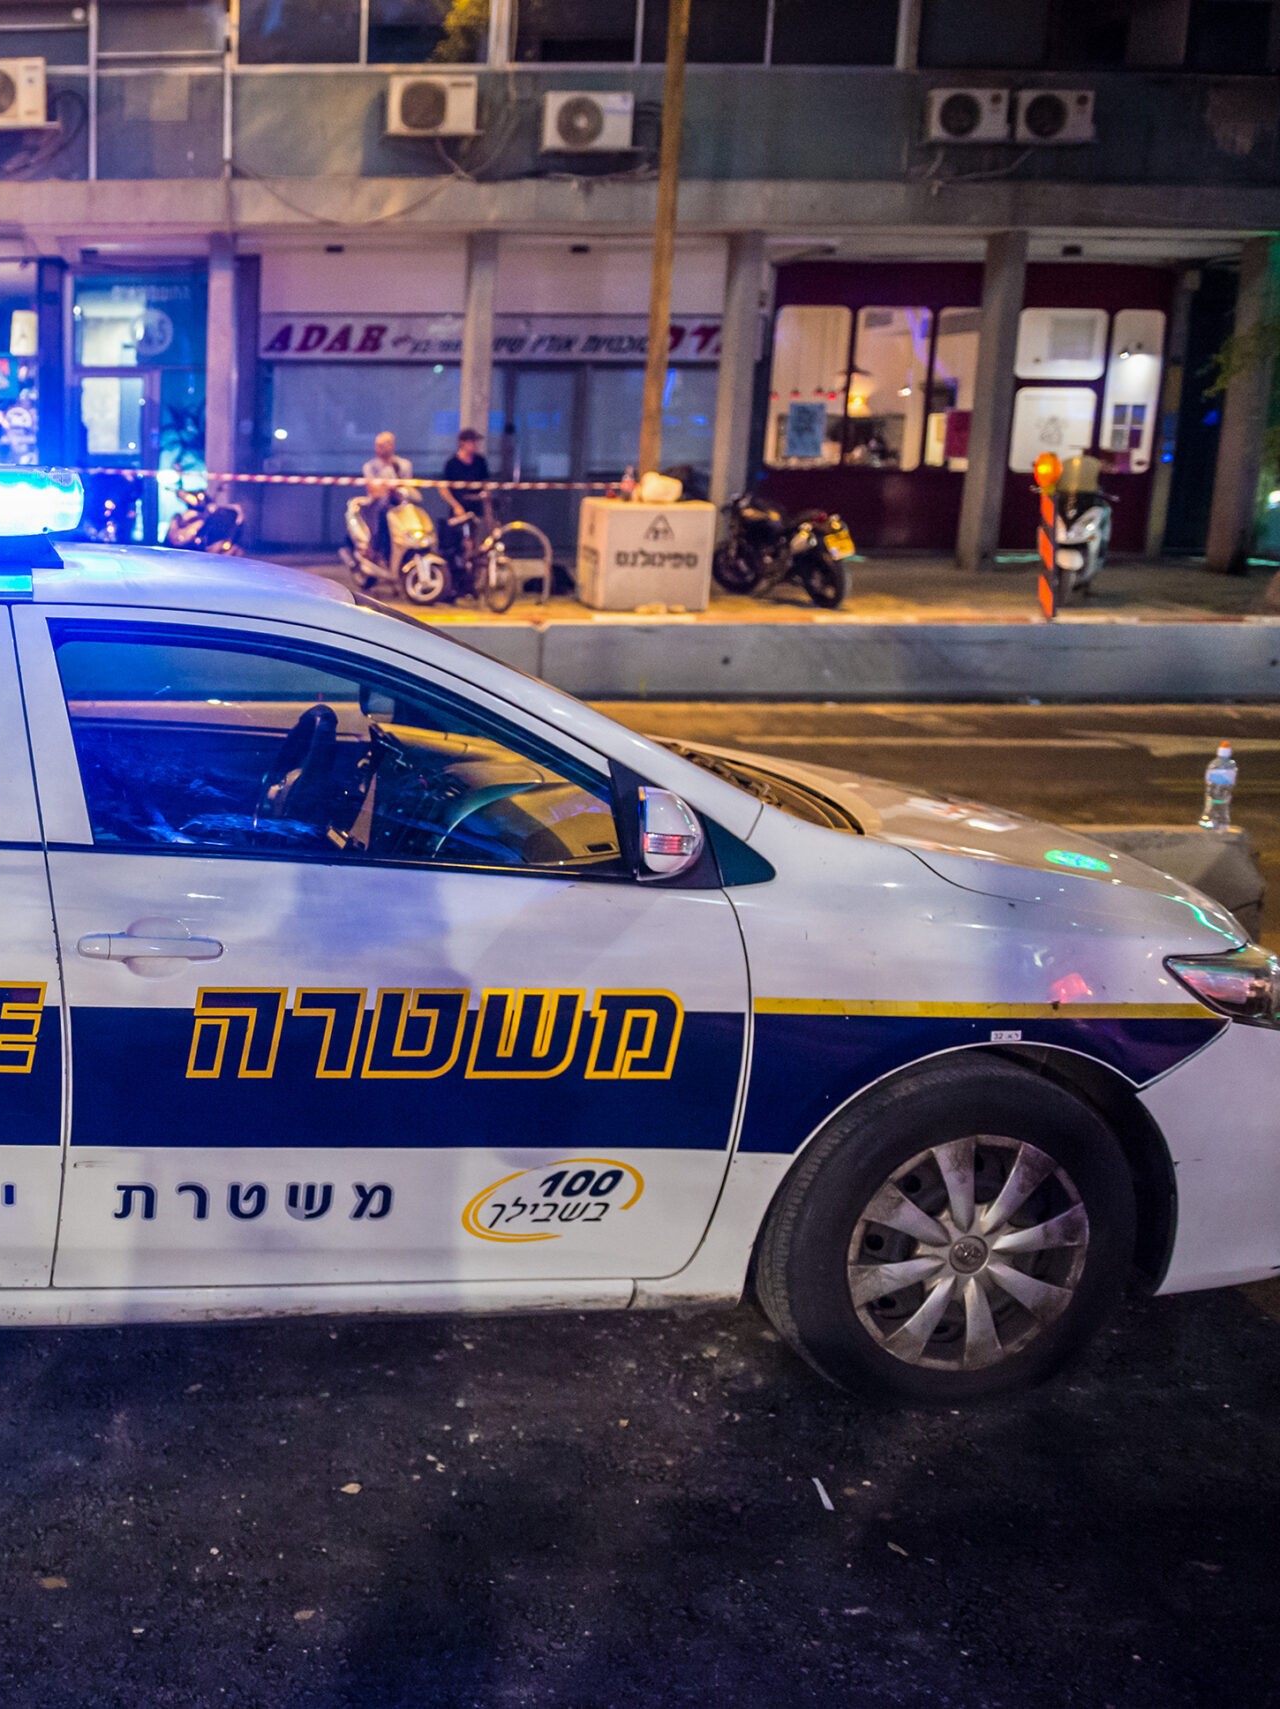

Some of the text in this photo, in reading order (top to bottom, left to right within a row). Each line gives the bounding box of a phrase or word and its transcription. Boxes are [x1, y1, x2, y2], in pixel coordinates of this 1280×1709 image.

[185, 986, 685, 1080] משטרה
[113, 1181, 395, 1222] משטרת
[539, 1169, 625, 1198] 100
[488, 1196, 611, 1229] בשבילך
